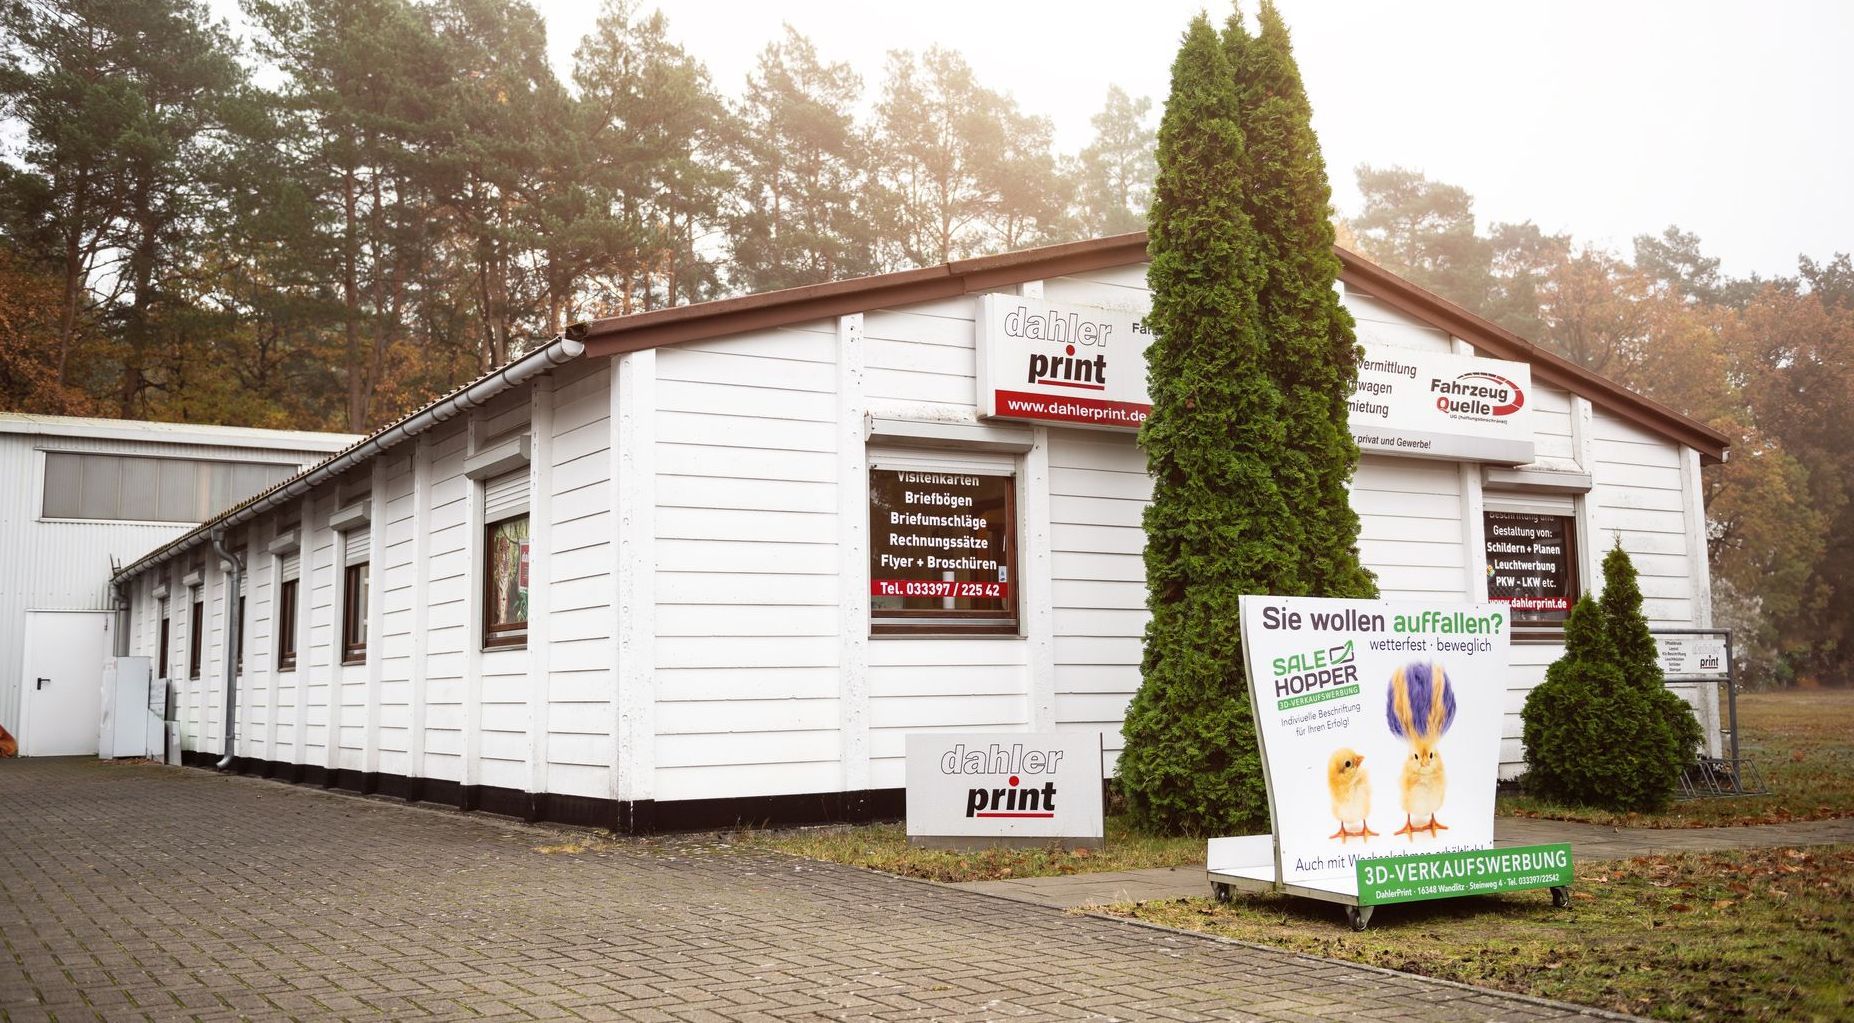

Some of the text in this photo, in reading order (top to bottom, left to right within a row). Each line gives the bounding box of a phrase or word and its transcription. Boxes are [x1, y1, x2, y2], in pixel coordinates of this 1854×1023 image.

[1004, 306, 1112, 347] dahler
[1027, 344, 1107, 384] print
[1430, 378, 1508, 403] Fahrzeug
[1008, 400, 1147, 422] www.dahlerprint.de
[1436, 396, 1490, 415] Quelle
[1357, 435, 1379, 444] privat
[1381, 437, 1395, 446] und
[1397, 438, 1431, 449] Gewerbe!
[898, 471, 979, 486] Visitenkarten
[905, 491, 973, 508] Briefbögen
[890, 511, 987, 530] Briefumschläge
[889, 533, 989, 550] Rechnungssätze
[1493, 525, 1553, 539] Gestaltung von:
[1487, 542, 1526, 553] Schildern
[1533, 544, 1561, 555] Planen
[881, 554, 914, 569] Flyer
[927, 556, 997, 570] Broschüren
[1494, 559, 1556, 573] Leuchtwerbung
[880, 582, 903, 595] Tel.
[906, 583, 950, 596] 033397
[961, 584, 983, 596] 225
[985, 584, 1000, 597] 42
[1496, 576, 1515, 587] PKW
[1522, 577, 1541, 587] LKW
[1542, 580, 1557, 588] etc.
[1262, 606, 1503, 635] Sie wollen auffallen?
[1369, 636, 1426, 652] wetterfest
[1436, 637, 1492, 656] beweglich
[1273, 649, 1327, 676] SALE
[1700, 655, 1719, 669] print
[1275, 664, 1358, 697] HOPPER
[1279, 686, 1358, 709] 3D-VERKAUFSWERBUNG
[1318, 703, 1361, 719] Beschriftung
[1296, 717, 1350, 736] für Ihren Erfolg!
[941, 744, 1063, 774] dahler
[966, 775, 1056, 818] print
[1296, 858, 1324, 872] Auch
[1328, 855, 1345, 869] mit
[1364, 850, 1567, 885] 3D-VERKAUFSWERBUNG
[1376, 888, 1412, 899] DahlerPrint
[1417, 885, 1437, 895] 16348
[1438, 882, 1465, 893] Wandlitz
[1469, 880, 1498, 890] Steinweg
[1507, 878, 1518, 886] Tel.
[1519, 873, 1560, 885] 033397/22542
